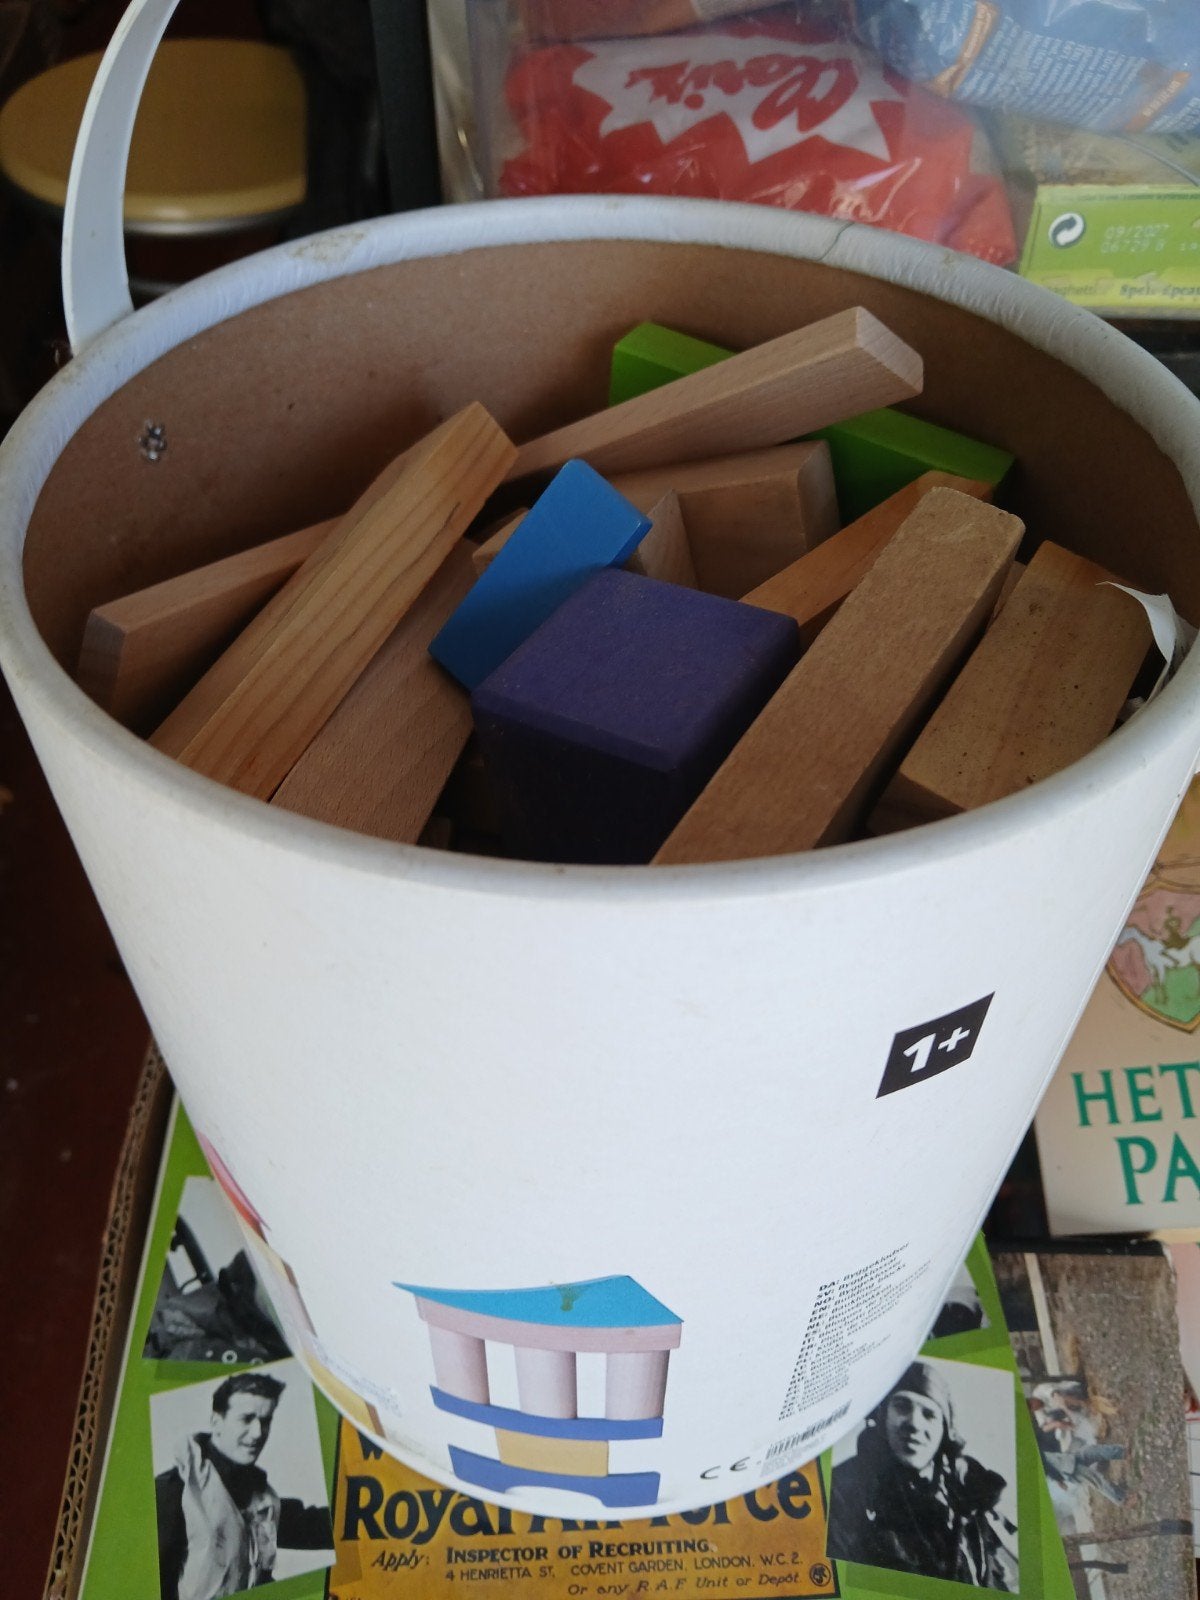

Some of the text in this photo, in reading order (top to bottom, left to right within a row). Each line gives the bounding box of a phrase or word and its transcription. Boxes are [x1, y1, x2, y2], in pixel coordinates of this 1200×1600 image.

[902, 1026, 971, 1073] 1+
[1070, 1060, 1200, 1128] HET
[1113, 1131, 1200, 1206] PA
[650, 1470, 812, 1528] rce
[371, 1549, 430, 1572] Apply:
[446, 1546, 548, 1565] INSPECTOR
[558, 1545, 582, 1560] OF
[445, 1570, 455, 1582] 4
[460, 1566, 532, 1581] HENRIETTA
[570, 1561, 624, 1576] COVENT
[568, 1583, 588, 1596] Or
[596, 1584, 630, 1596] any
[695, 1576, 729, 1589] Unit
[736, 1576, 752, 1588] or
